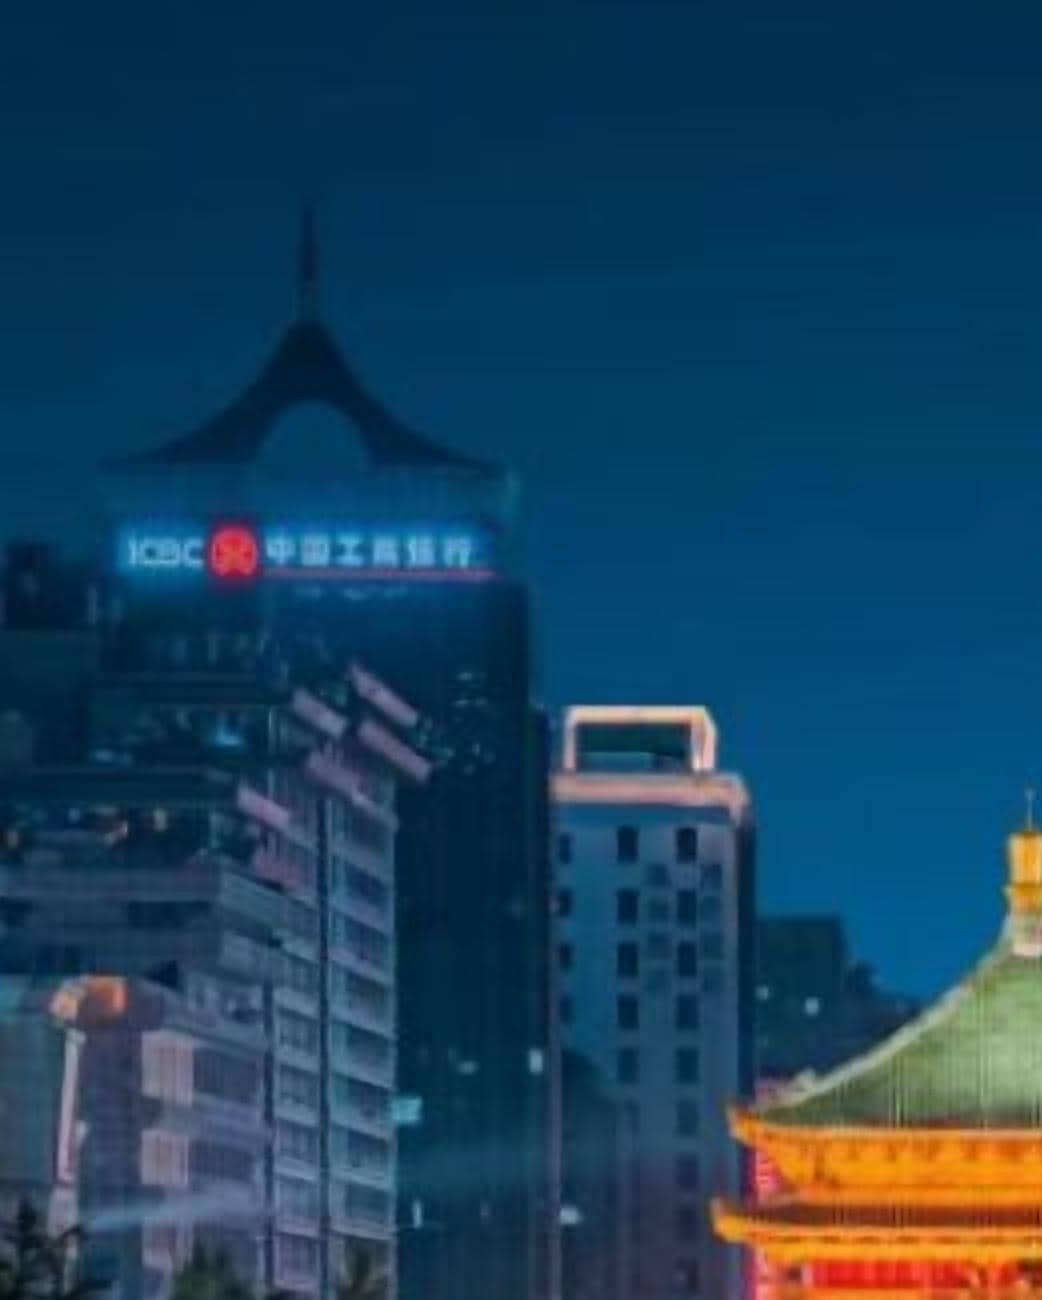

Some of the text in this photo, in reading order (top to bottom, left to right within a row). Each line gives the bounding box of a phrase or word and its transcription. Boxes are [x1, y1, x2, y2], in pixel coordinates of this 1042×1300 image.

[127, 531, 475, 568] ICBC 中国工商银行
